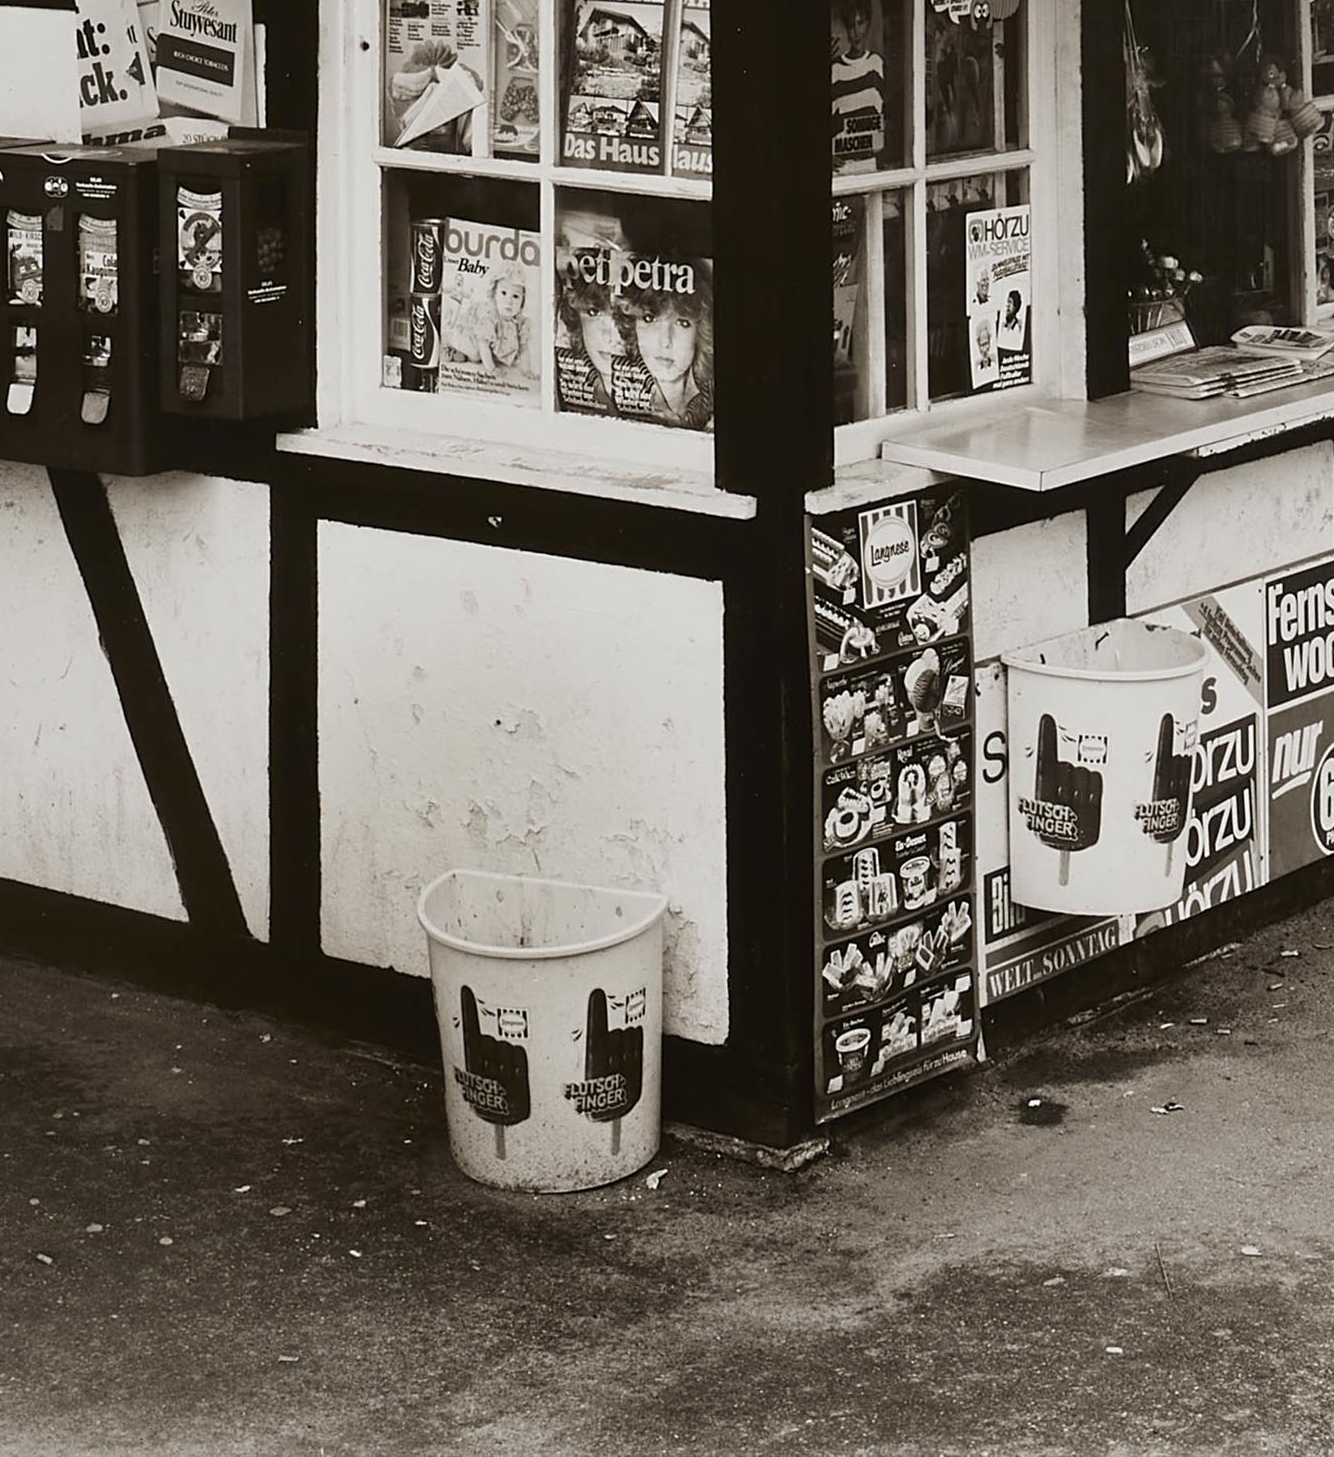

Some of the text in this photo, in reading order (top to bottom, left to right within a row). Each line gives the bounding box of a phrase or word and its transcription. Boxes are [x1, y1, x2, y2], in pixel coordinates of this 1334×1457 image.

[170, 0, 237, 43] Stuyvesant
[564, 133, 660, 166] Das Haus
[444, 228, 540, 268] burda
[457, 258, 490, 280] Baby
[614, 256, 696, 296] petra
[871, 540, 909, 567] Langnese
[1272, 720, 1323, 785] nur
[1026, 814, 1075, 838] FINGER
[1143, 813, 1178, 831] FINGER
[989, 926, 1116, 997] WELT SONNTAG
[942, 1048, 968, 1065] Hause
[574, 1089, 625, 1113] FINGER
